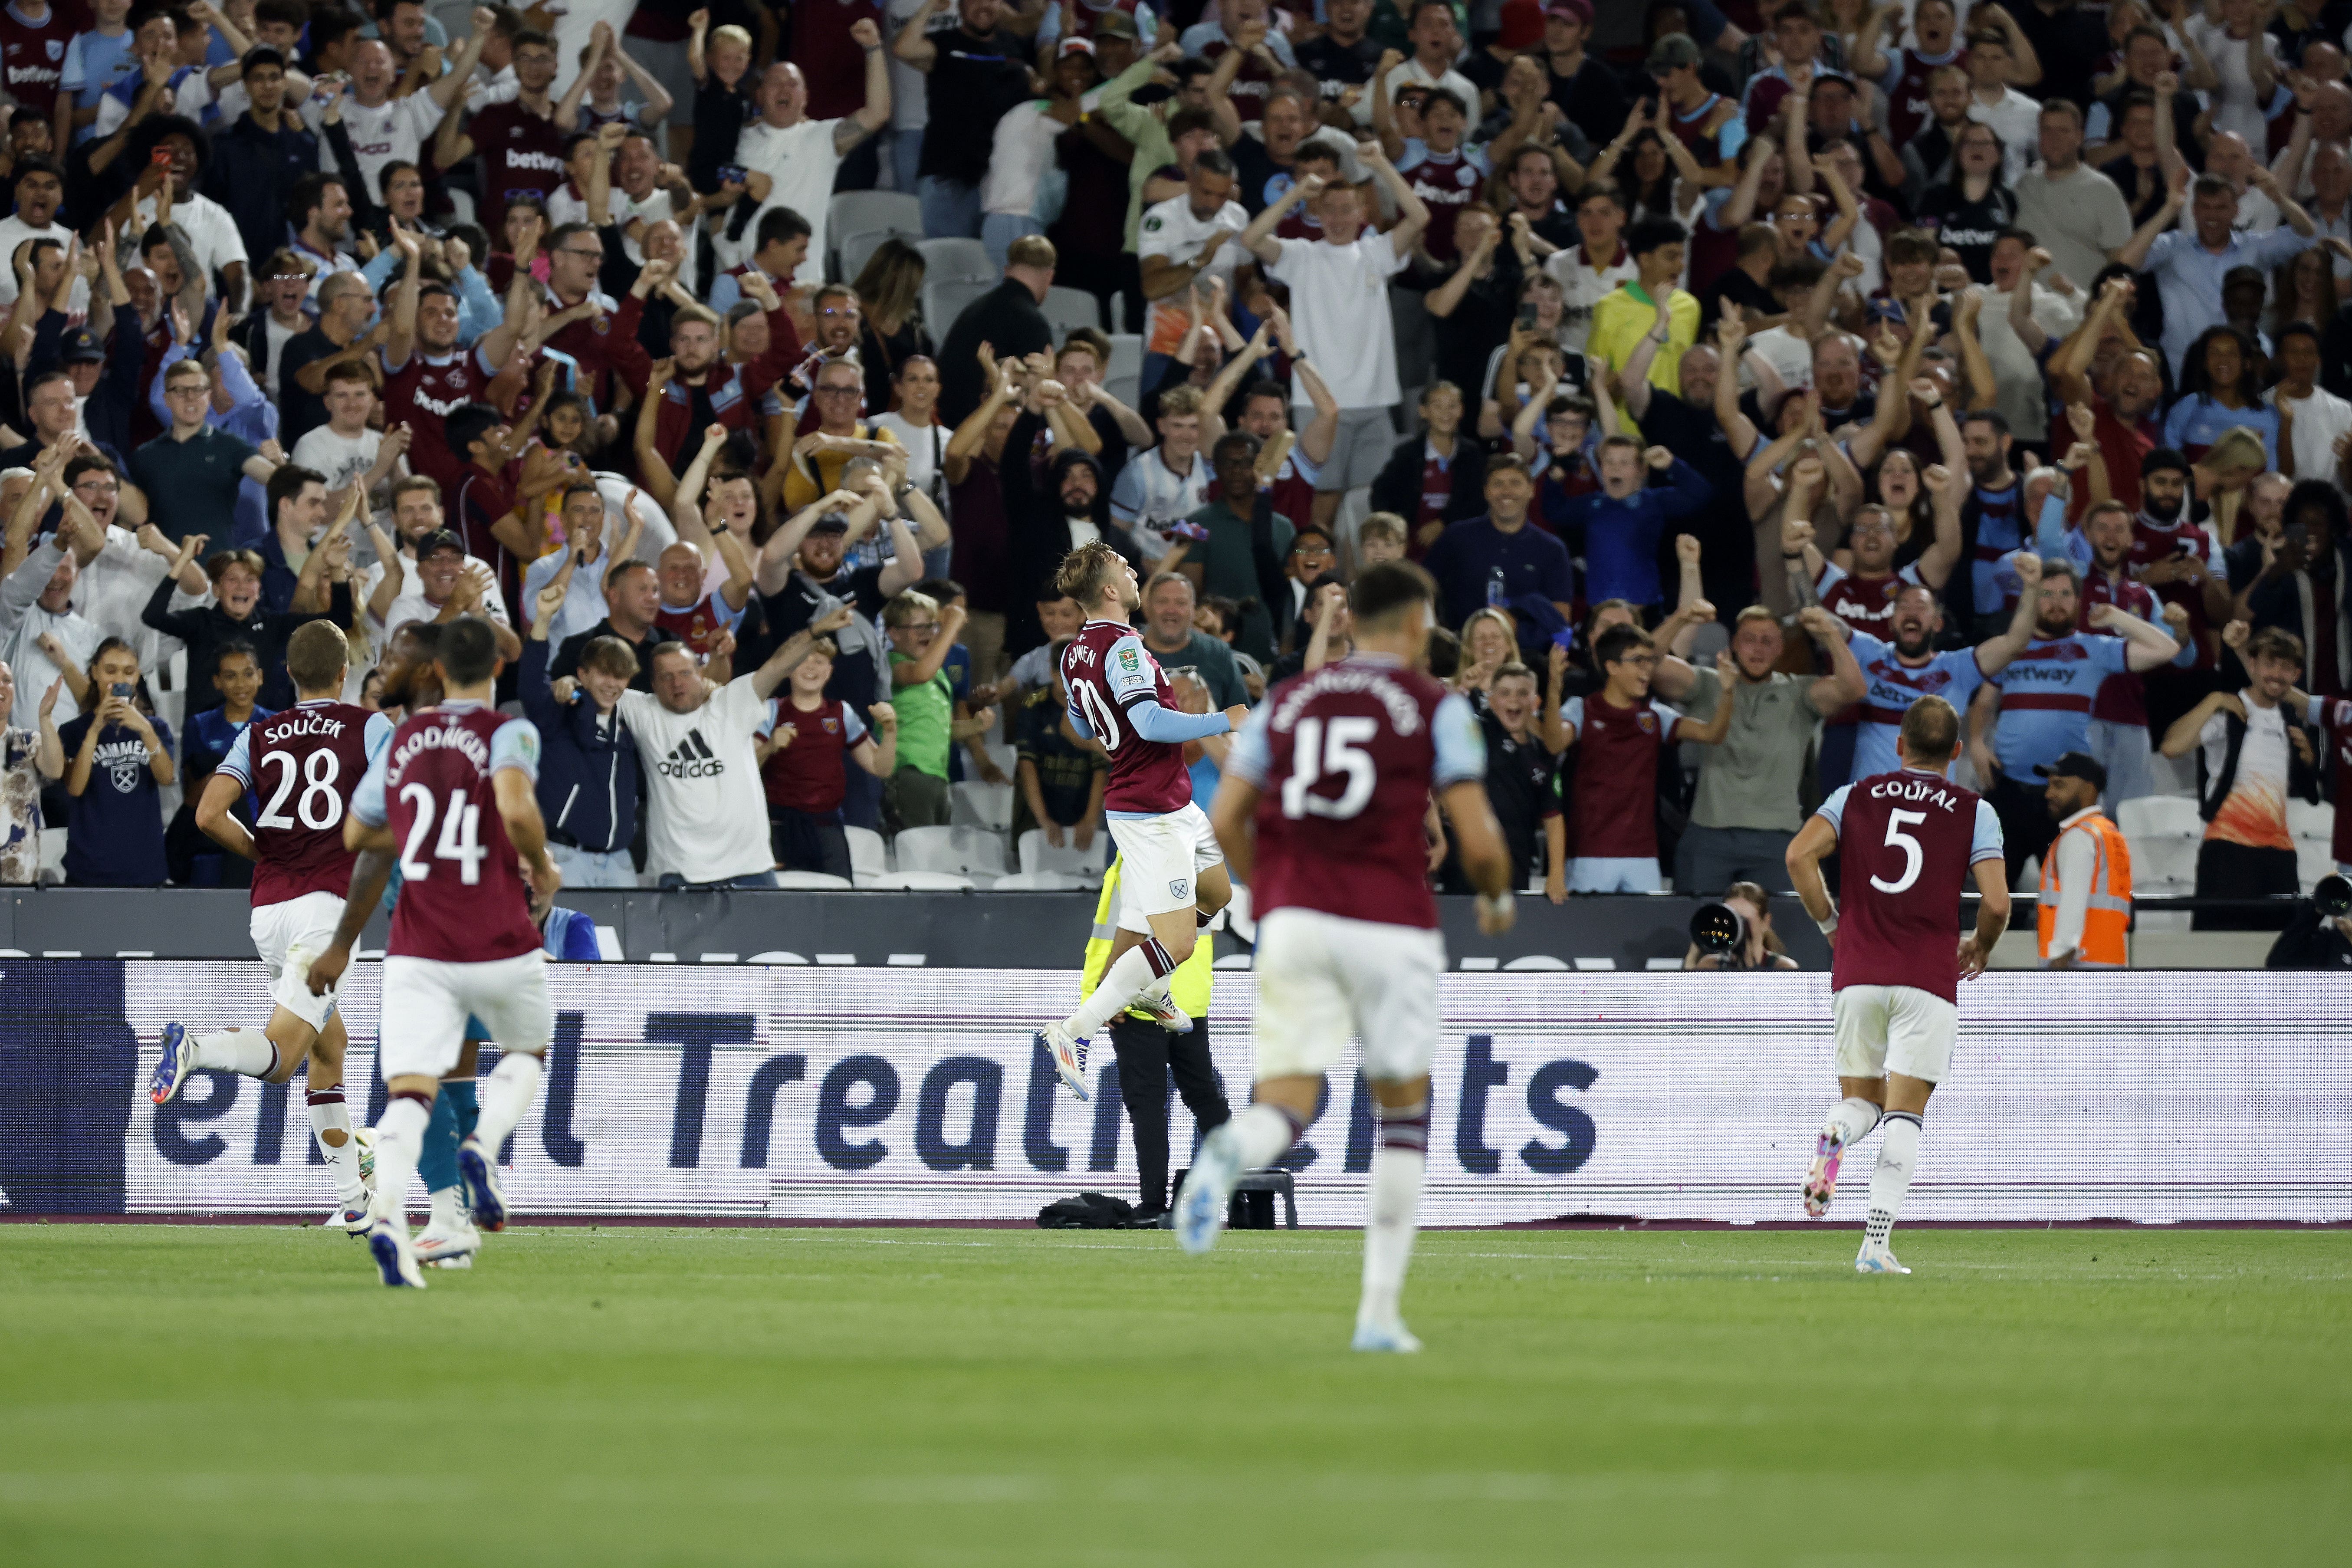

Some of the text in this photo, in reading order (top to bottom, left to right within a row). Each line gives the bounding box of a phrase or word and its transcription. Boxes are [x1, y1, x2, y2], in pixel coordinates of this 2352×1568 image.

[1068, 644, 1096, 670] BOWEN
[256, 747, 343, 830] 28
[658, 760, 723, 778] adidas
[1281, 716, 1379, 820] 15
[1871, 781, 1958, 813] COUFAL
[399, 782, 489, 885] 24
[1869, 807, 1927, 894] 5
